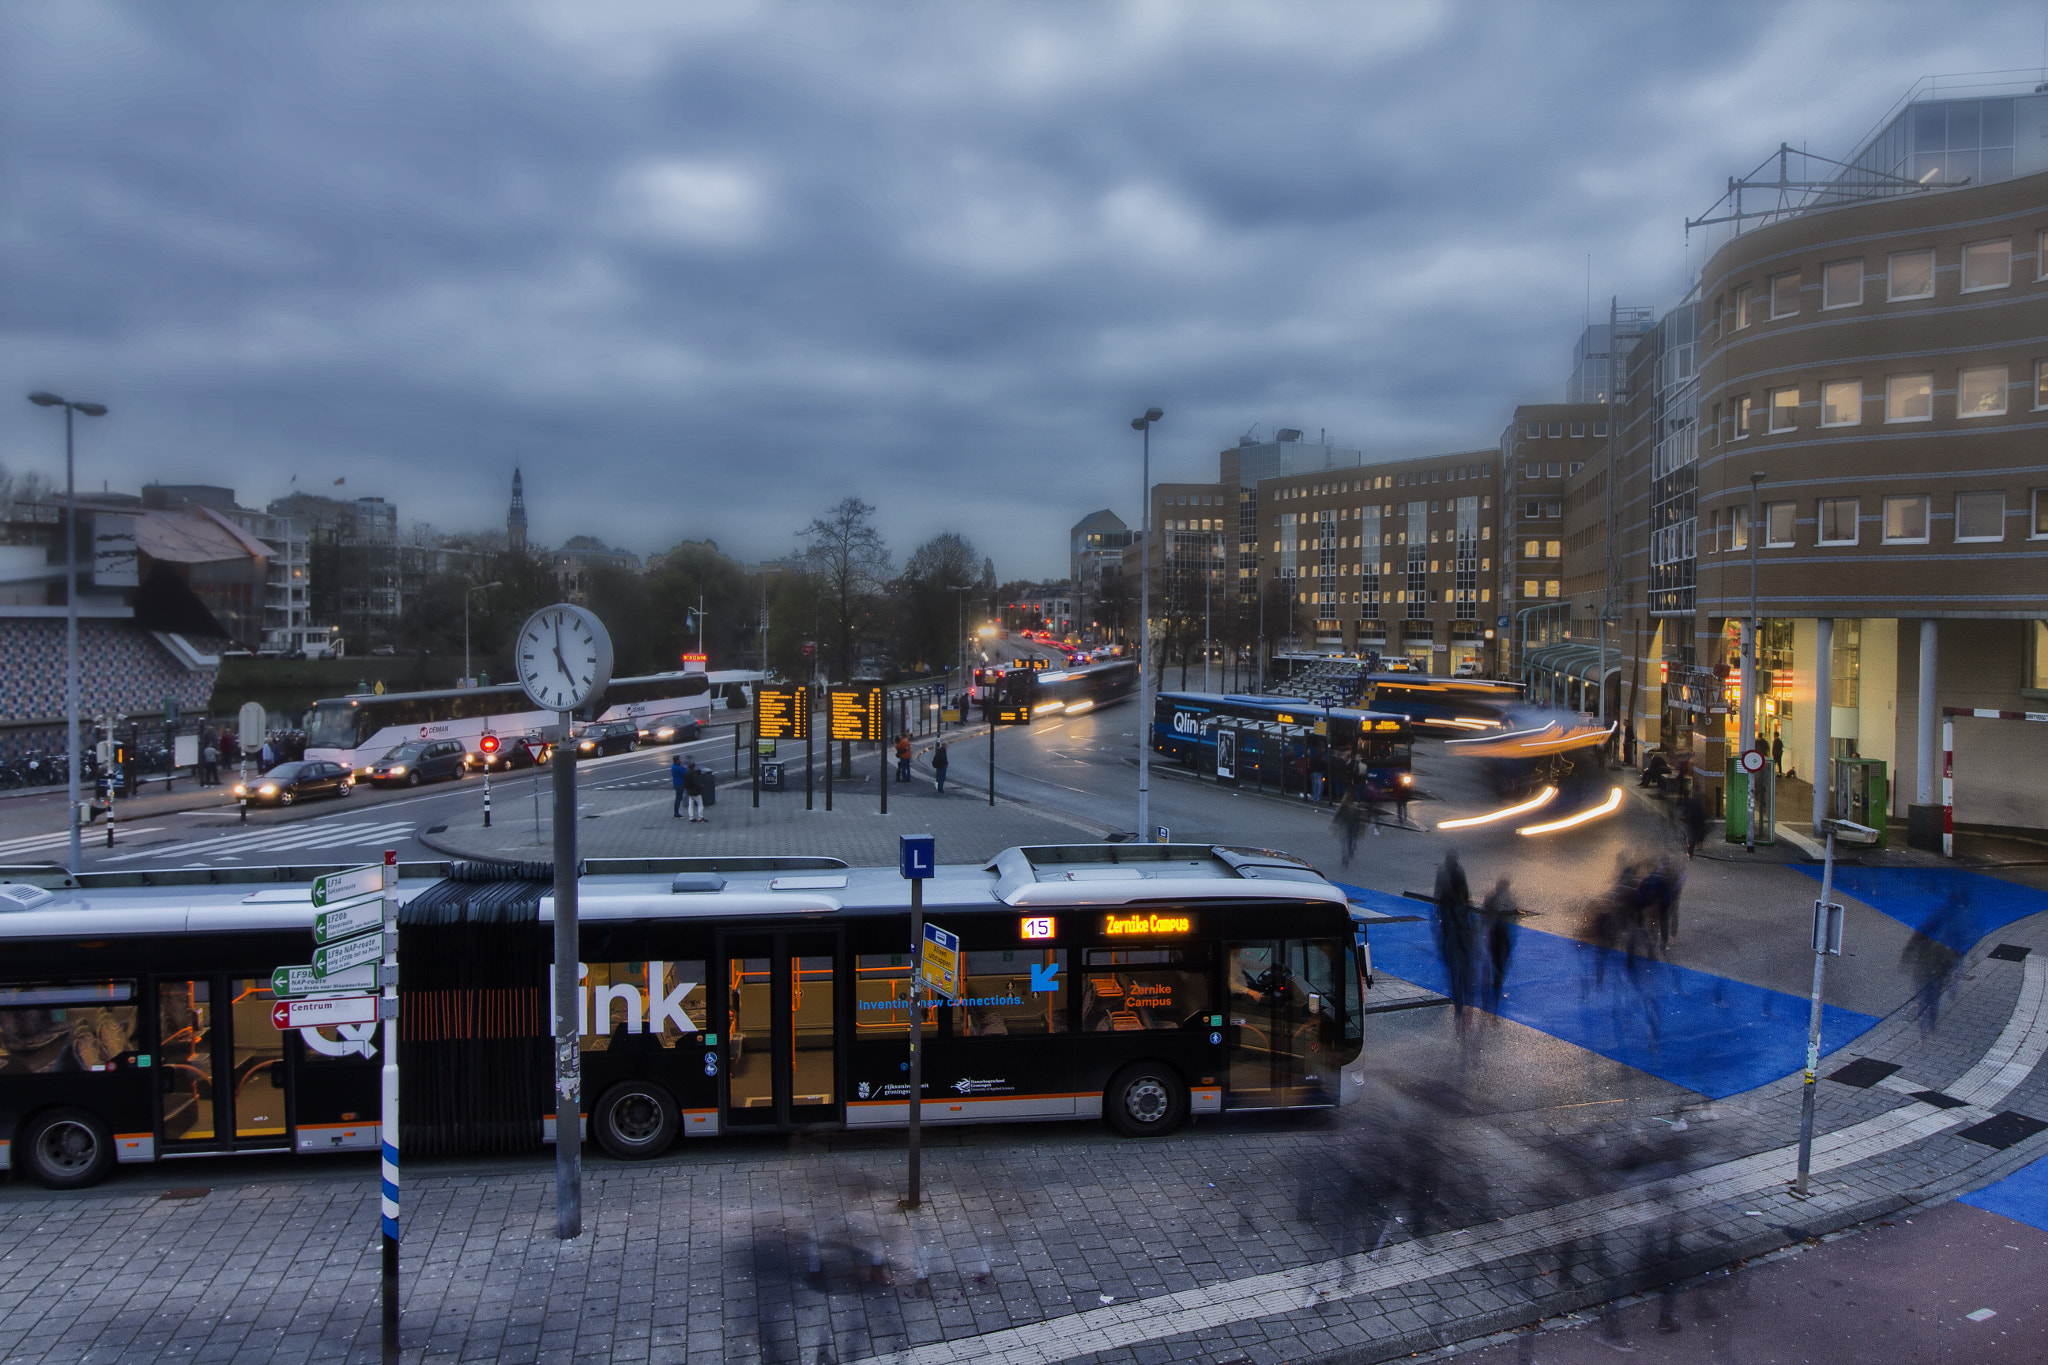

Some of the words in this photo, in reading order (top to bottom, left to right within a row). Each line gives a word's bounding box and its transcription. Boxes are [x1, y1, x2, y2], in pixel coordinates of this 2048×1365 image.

[913, 849, 927, 869] L
[327, 877, 342, 888] LF14
[327, 884, 356, 896] Saksenroute
[327, 912, 347, 924] LF20b
[1106, 915, 1149, 934] Zernike
[1150, 914, 1190, 933] Campus
[1026, 920, 1049, 936] 15
[327, 949, 343, 959] LF9a
[344, 939, 376, 954] NAP-route
[291, 970, 313, 979] LF9b
[291, 978, 327, 986] NAP-route
[1130, 983, 1172, 995] Zernike
[291, 1002, 333, 1012] Centrum
[920, 998, 944, 1008] new
[947, 994, 1025, 1008] connections.
[1126, 997, 1172, 1009] Campus
